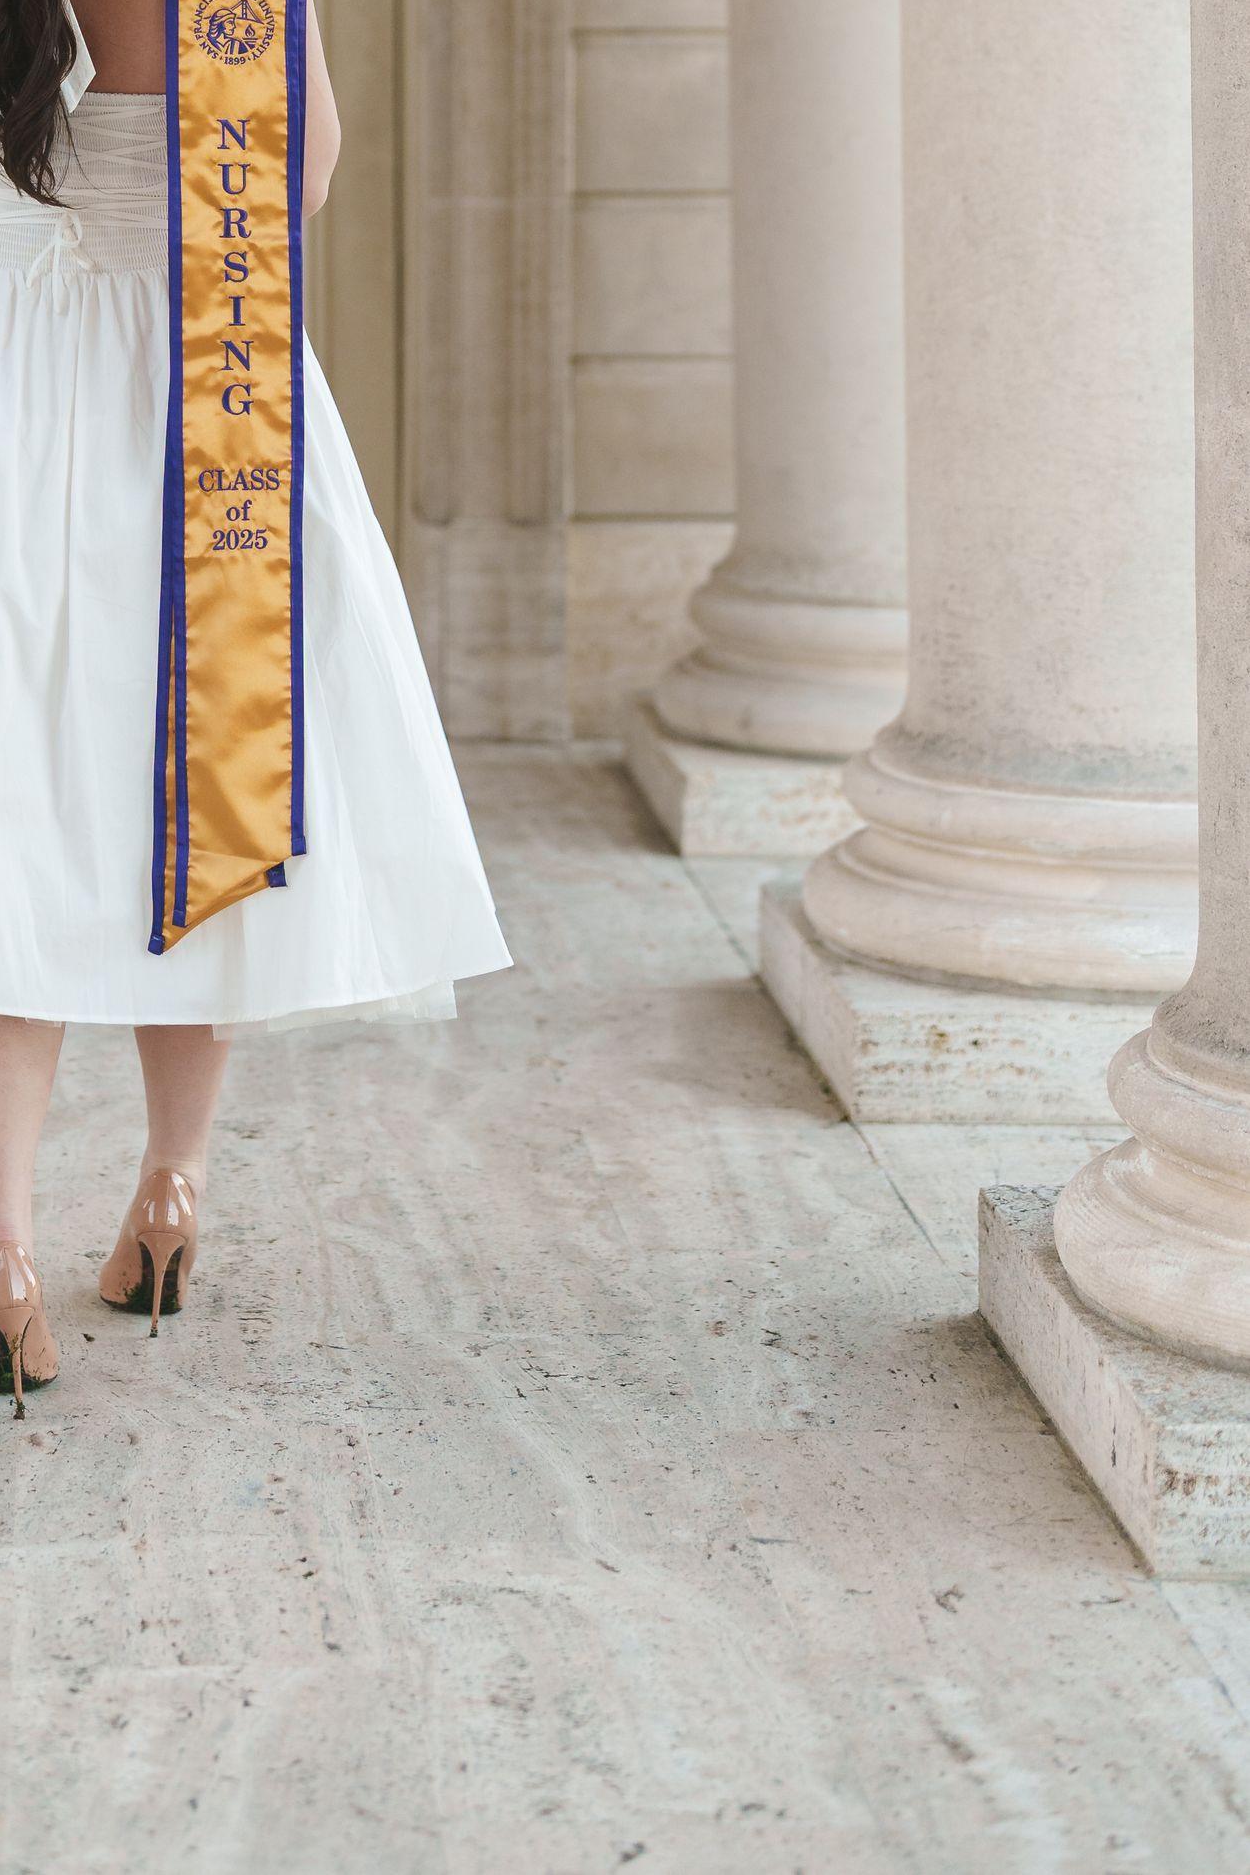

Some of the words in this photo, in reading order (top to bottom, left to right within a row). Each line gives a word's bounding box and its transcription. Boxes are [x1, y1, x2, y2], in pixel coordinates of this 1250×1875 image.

[199, 41, 219, 60] SAN
[251, 0, 275, 61] UNIVERSITY
[224, 56, 246, 65] 1899
[216, 118, 254, 416] NURSING
[198, 468, 281, 492] CLASS
[226, 499, 252, 522] of
[212, 528, 268, 551] 2025
